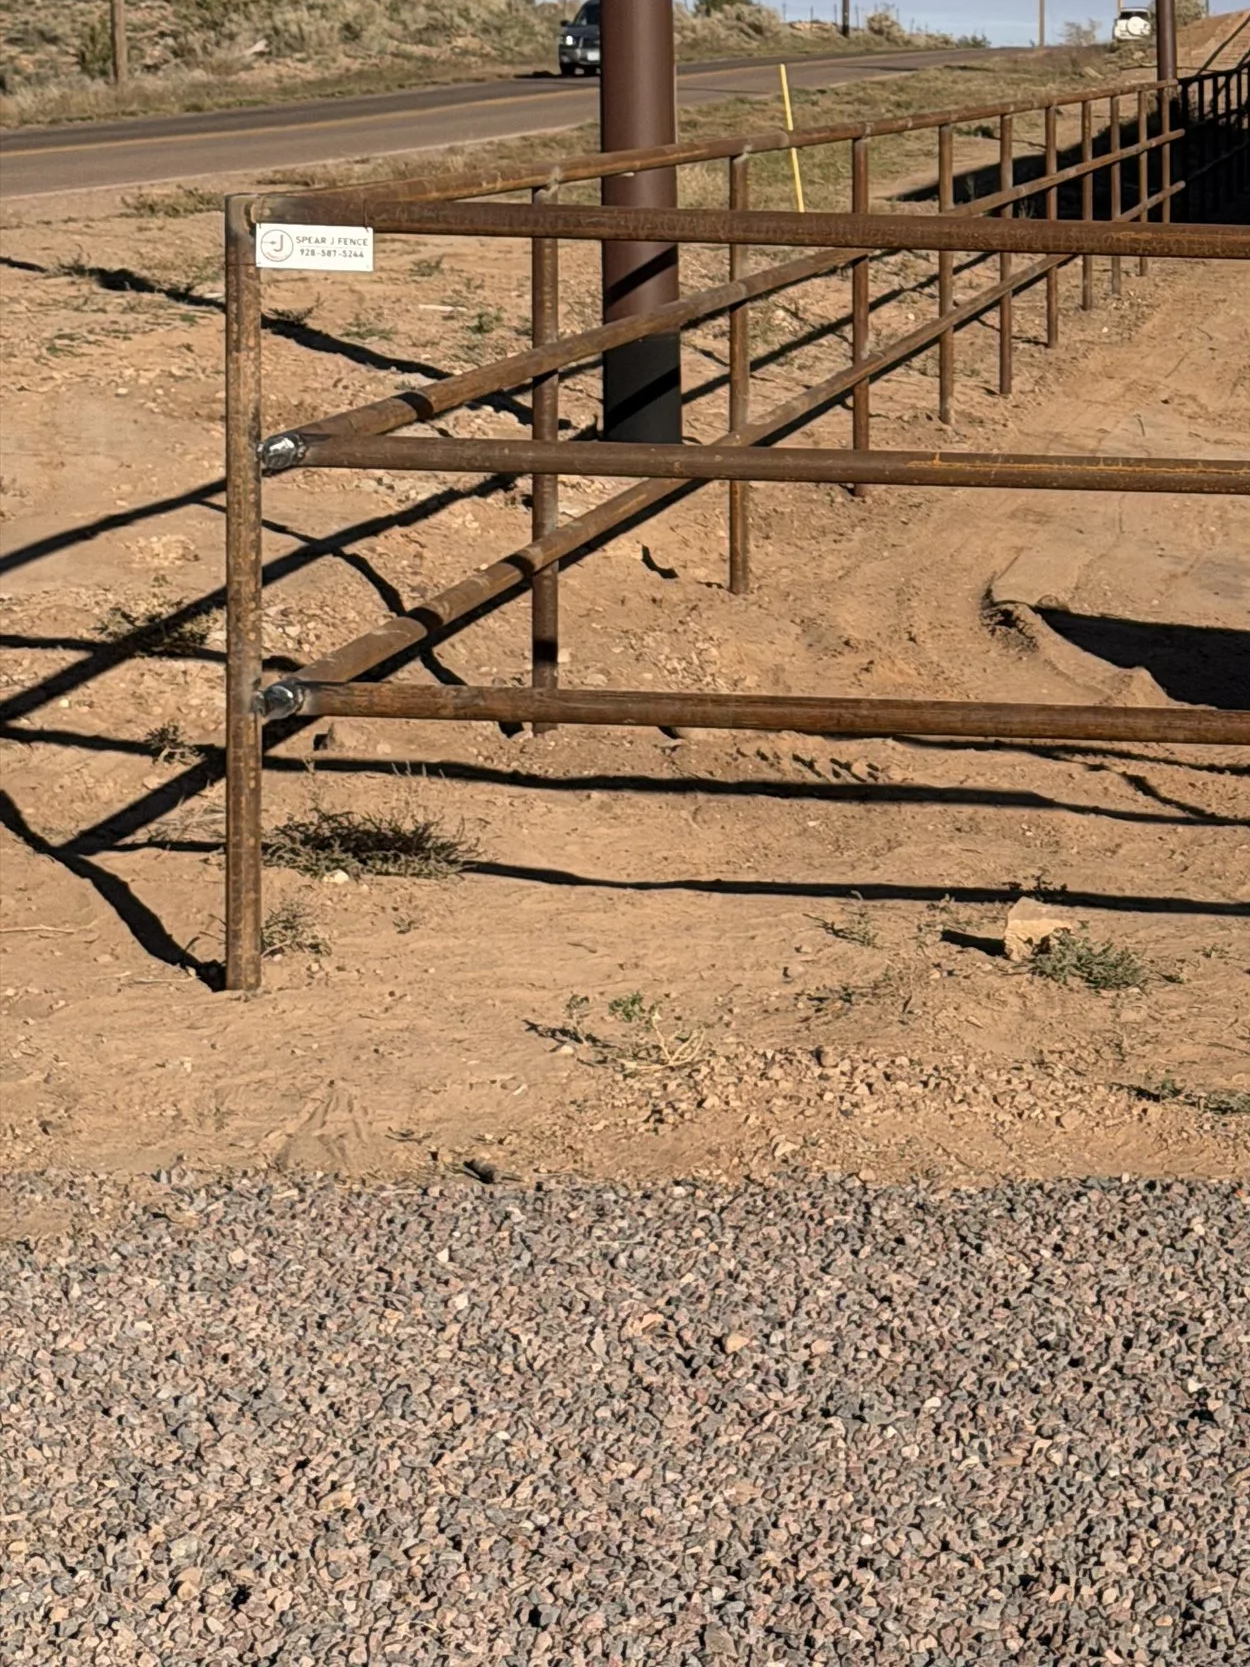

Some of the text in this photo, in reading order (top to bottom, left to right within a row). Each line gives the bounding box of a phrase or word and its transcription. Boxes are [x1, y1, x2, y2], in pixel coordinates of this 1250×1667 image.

[296, 236, 368, 246] SPEAR J FENCE
